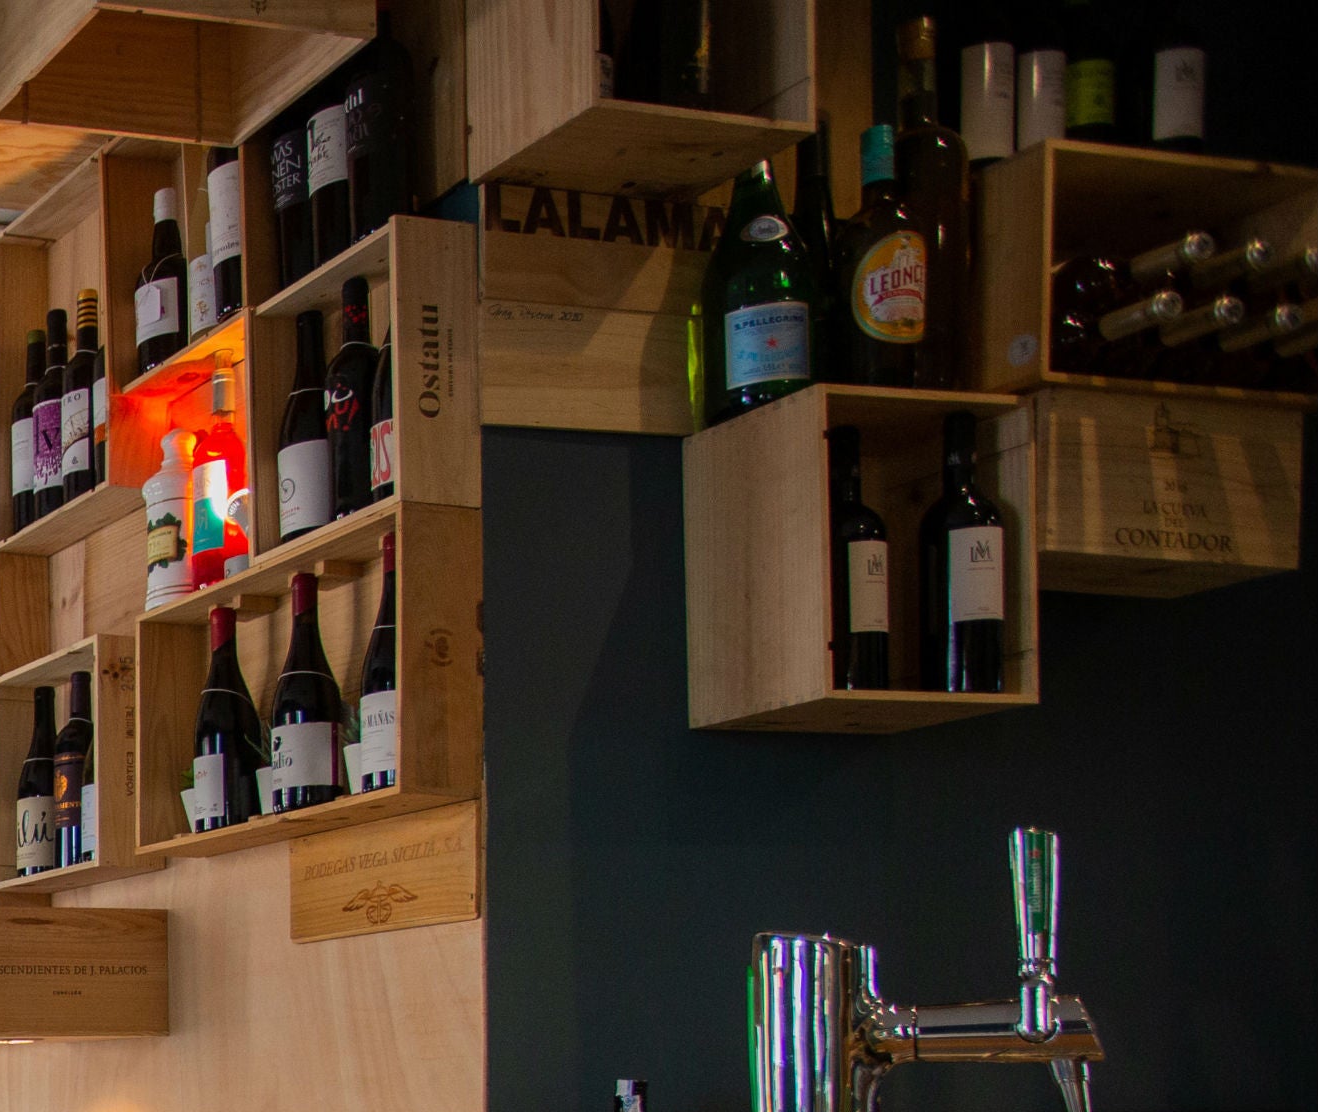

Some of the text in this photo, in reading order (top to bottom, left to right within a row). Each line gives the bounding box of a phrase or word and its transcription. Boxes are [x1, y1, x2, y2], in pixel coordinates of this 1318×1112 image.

[416, 303, 441, 419] Ostatu
[1115, 527, 1233, 552] CONTADOR
[304, 856, 357, 881] BODEGAS
[358, 852, 388, 870] VEGA
[73, 965, 87, 975] DE
[98, 965, 148, 976] PALACIOS
